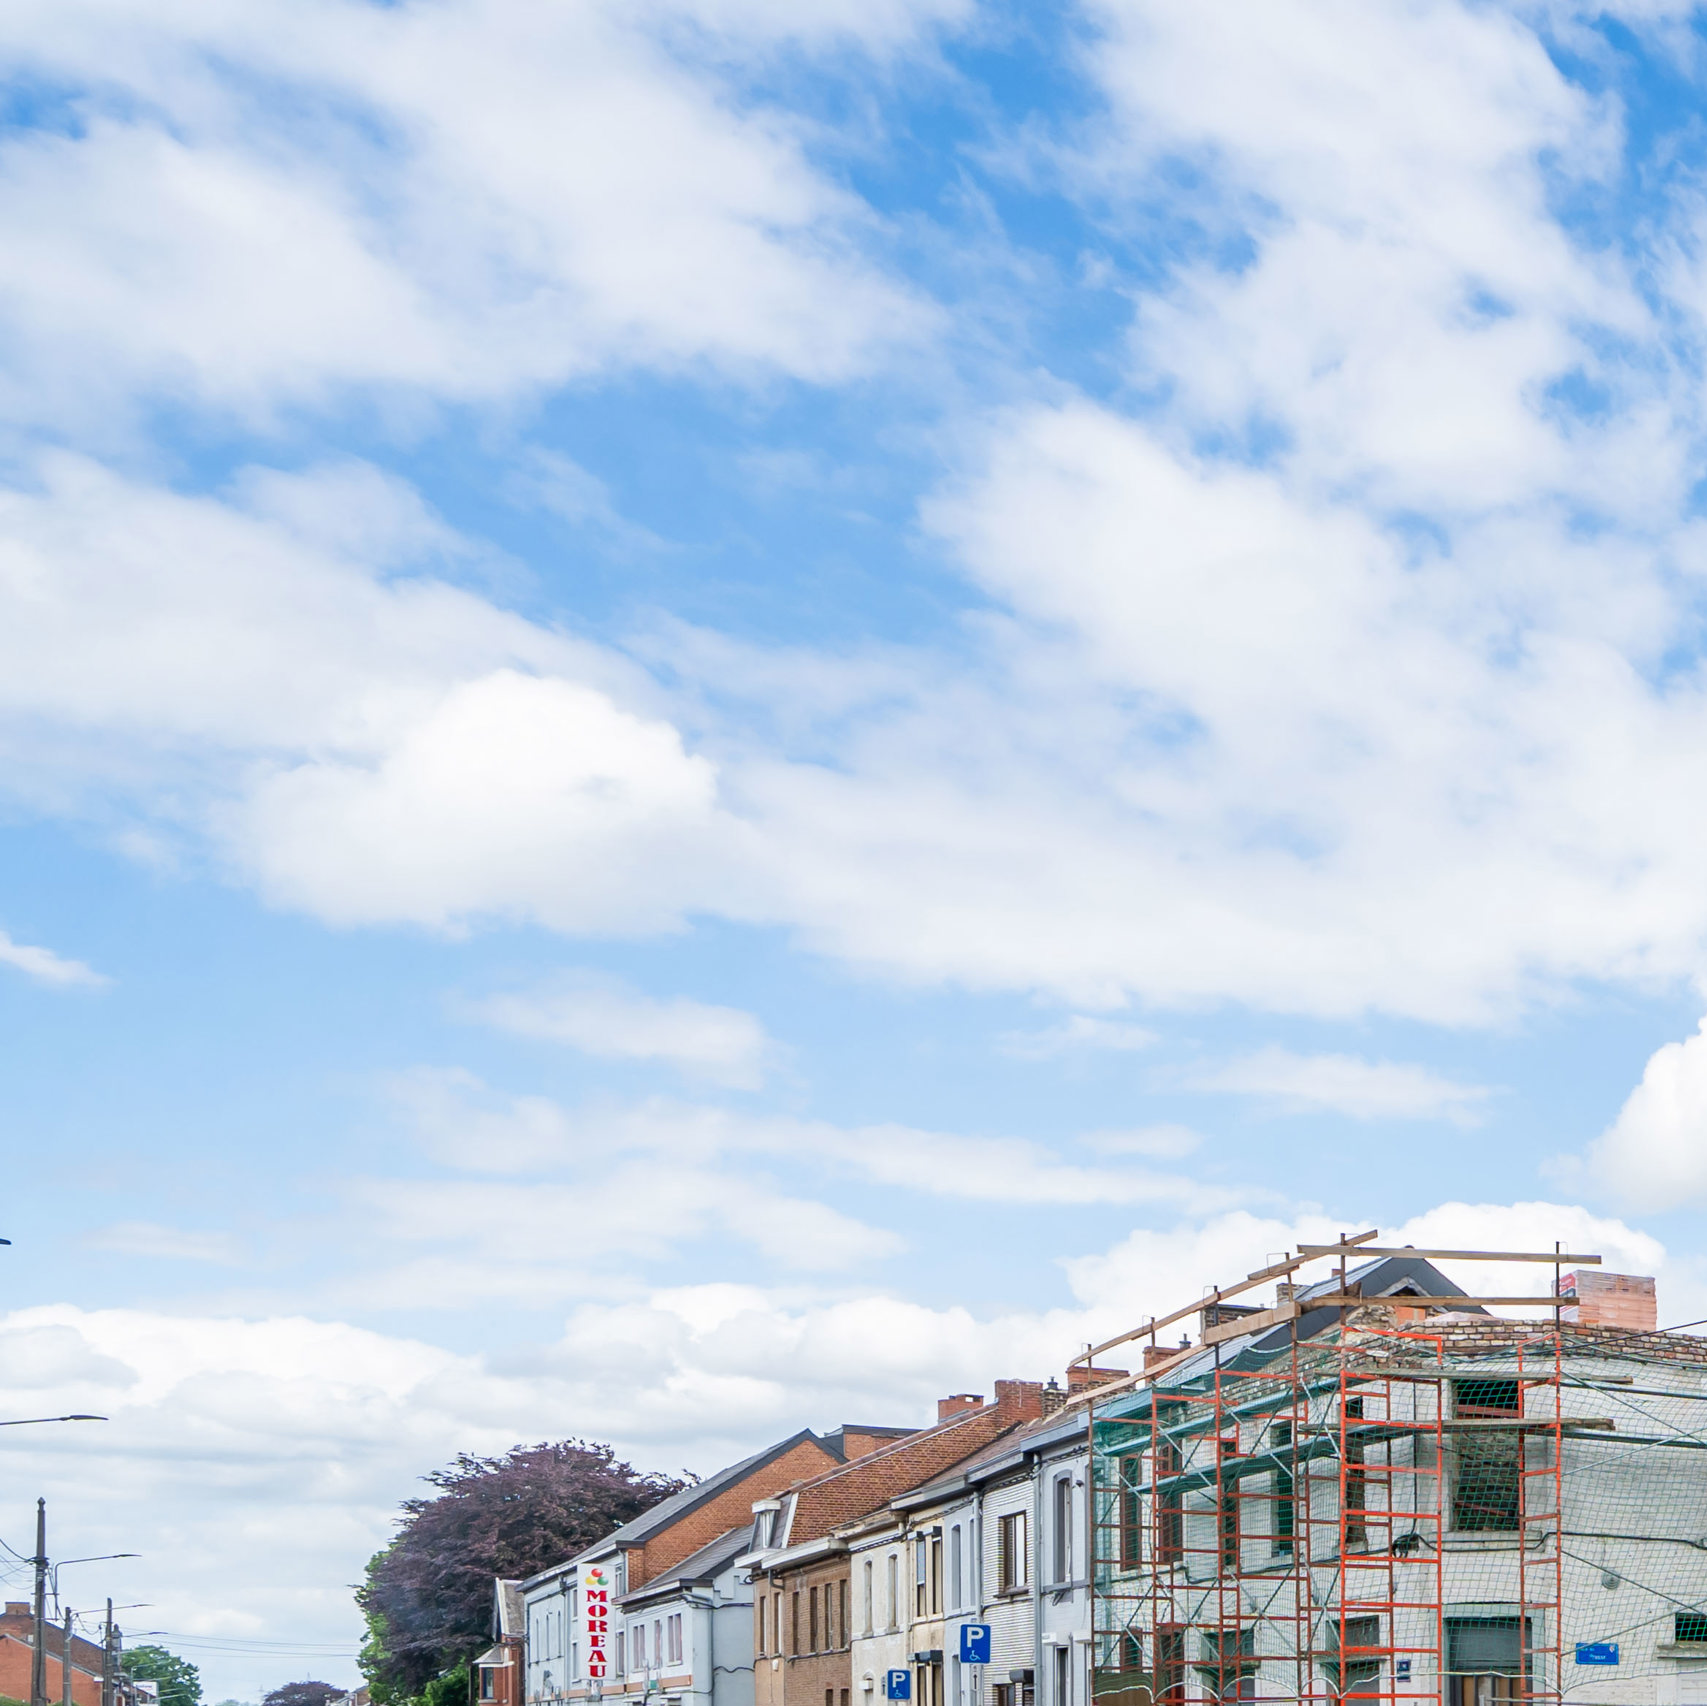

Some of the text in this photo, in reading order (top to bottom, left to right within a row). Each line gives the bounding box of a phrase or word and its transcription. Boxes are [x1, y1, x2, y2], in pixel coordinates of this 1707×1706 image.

[586, 1589, 608, 1678] MOREAU
[966, 1626, 985, 1648] P
[892, 1672, 906, 1688] P
